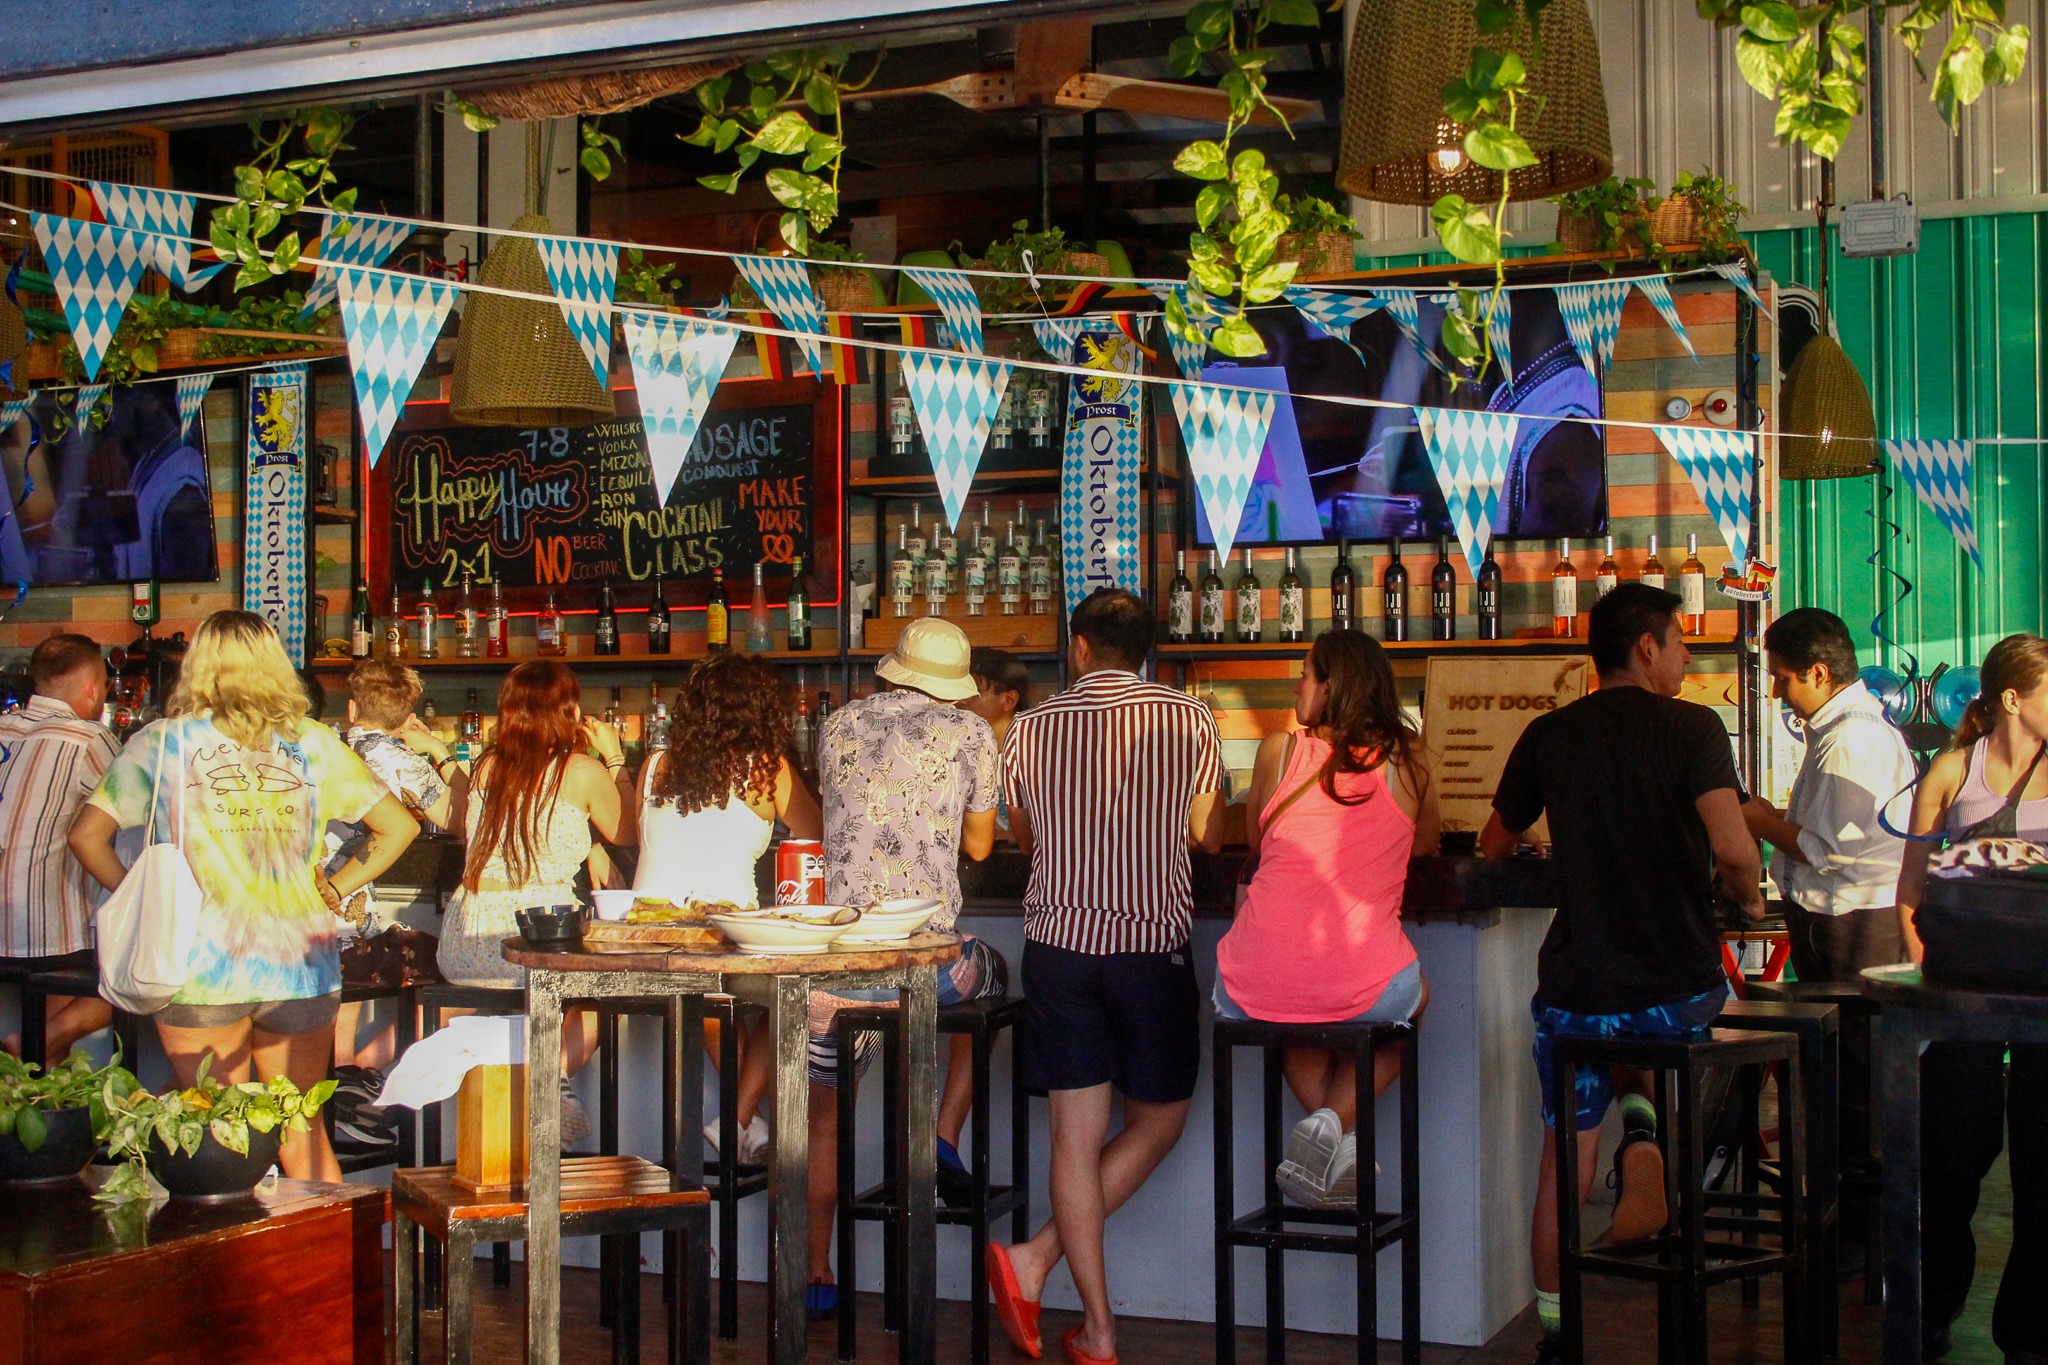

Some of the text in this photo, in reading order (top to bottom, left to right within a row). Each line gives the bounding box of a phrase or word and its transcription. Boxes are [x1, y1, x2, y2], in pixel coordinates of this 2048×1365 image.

[1086, 406, 1117, 418] Prost
[599, 439, 637, 456] VODKA
[265, 454, 288, 465] Prost
[401, 454, 501, 545] Happy
[602, 494, 636, 509] RON
[739, 476, 806, 510] MAKE
[601, 507, 637, 529] GIN
[755, 509, 804, 533] YOUR
[572, 533, 607, 550] BEER
[535, 535, 572, 584] NO
[572, 560, 621, 580] COCKTAIL
[1449, 695, 1558, 711] HOT DOGS
[214, 804, 264, 818] SURF
